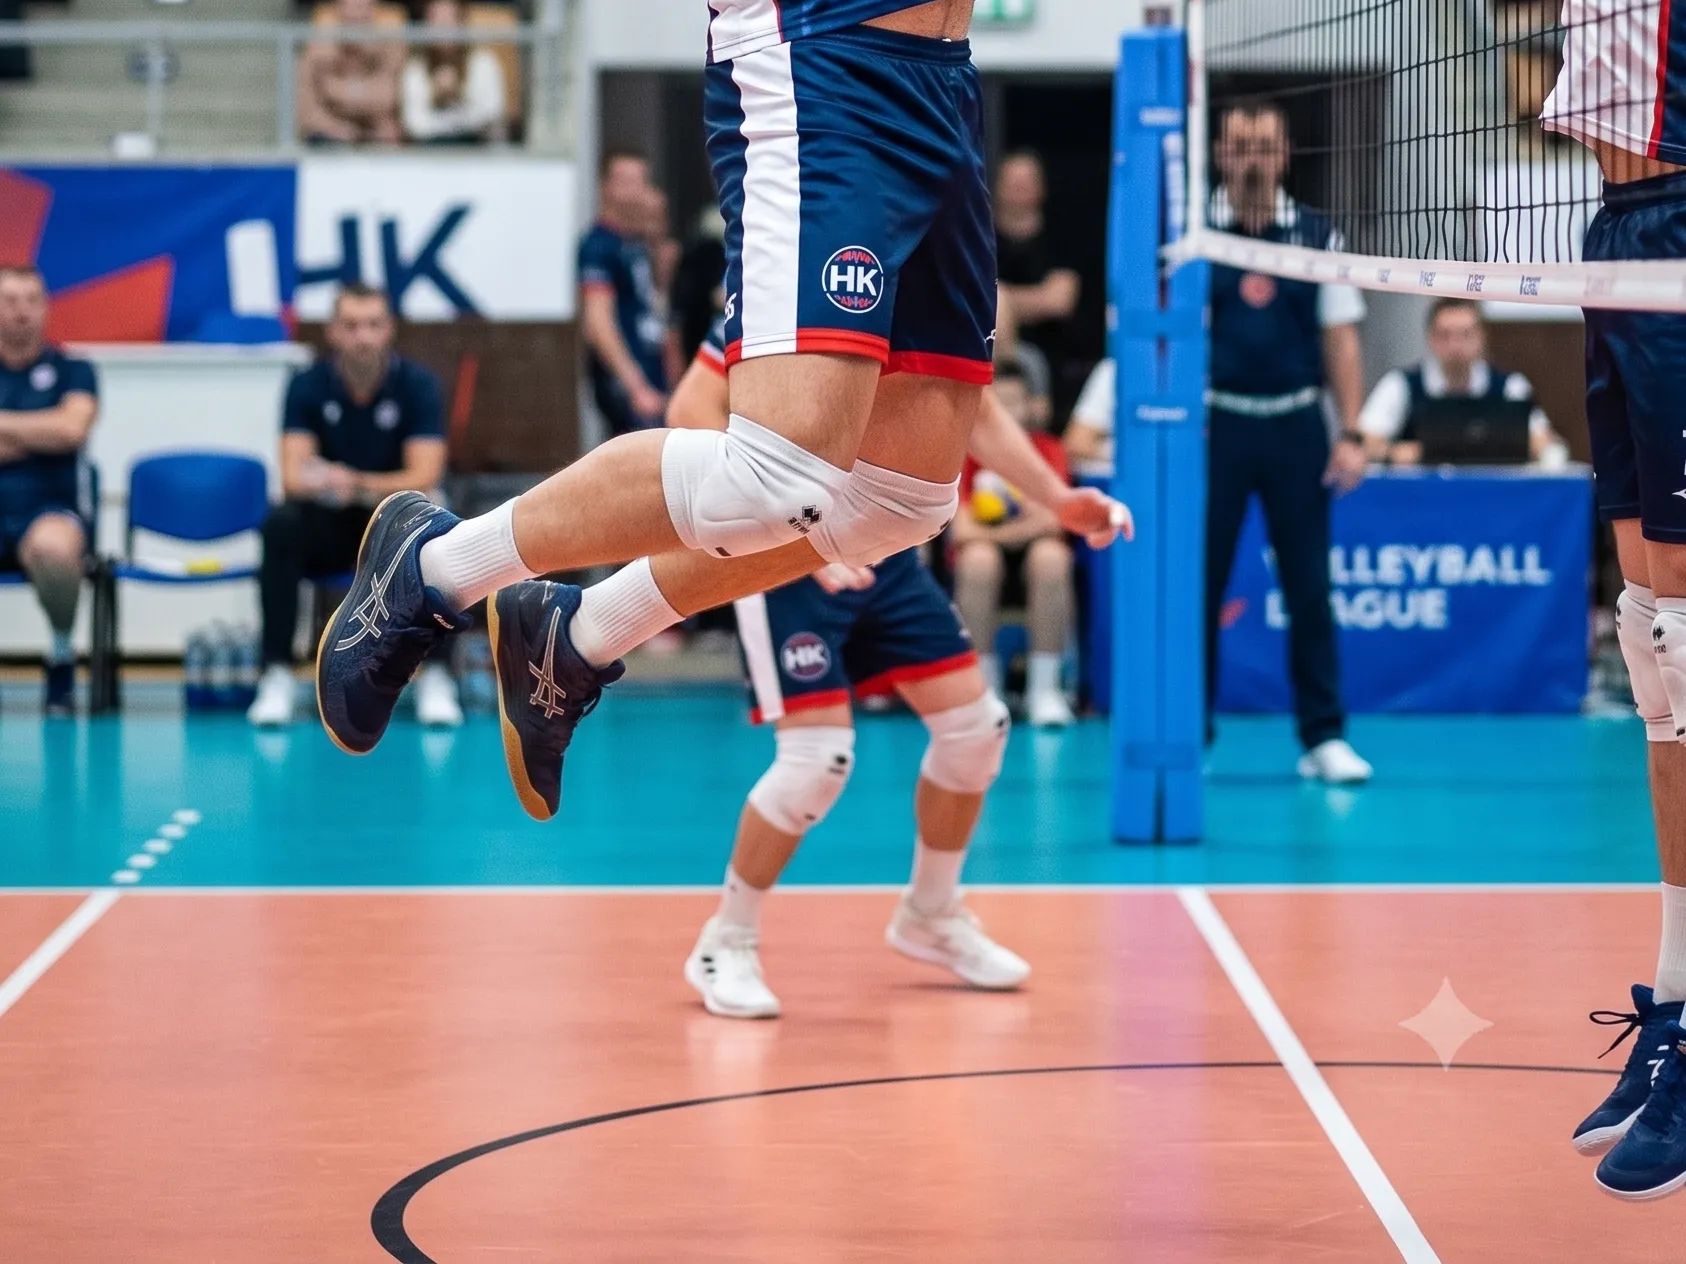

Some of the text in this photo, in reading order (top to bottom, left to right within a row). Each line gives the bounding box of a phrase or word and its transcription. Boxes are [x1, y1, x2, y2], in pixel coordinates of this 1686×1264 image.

[829, 264, 879, 296] HK
[1261, 542, 1551, 586] LLEYBALL
[1265, 587, 1447, 630] LAGUE
